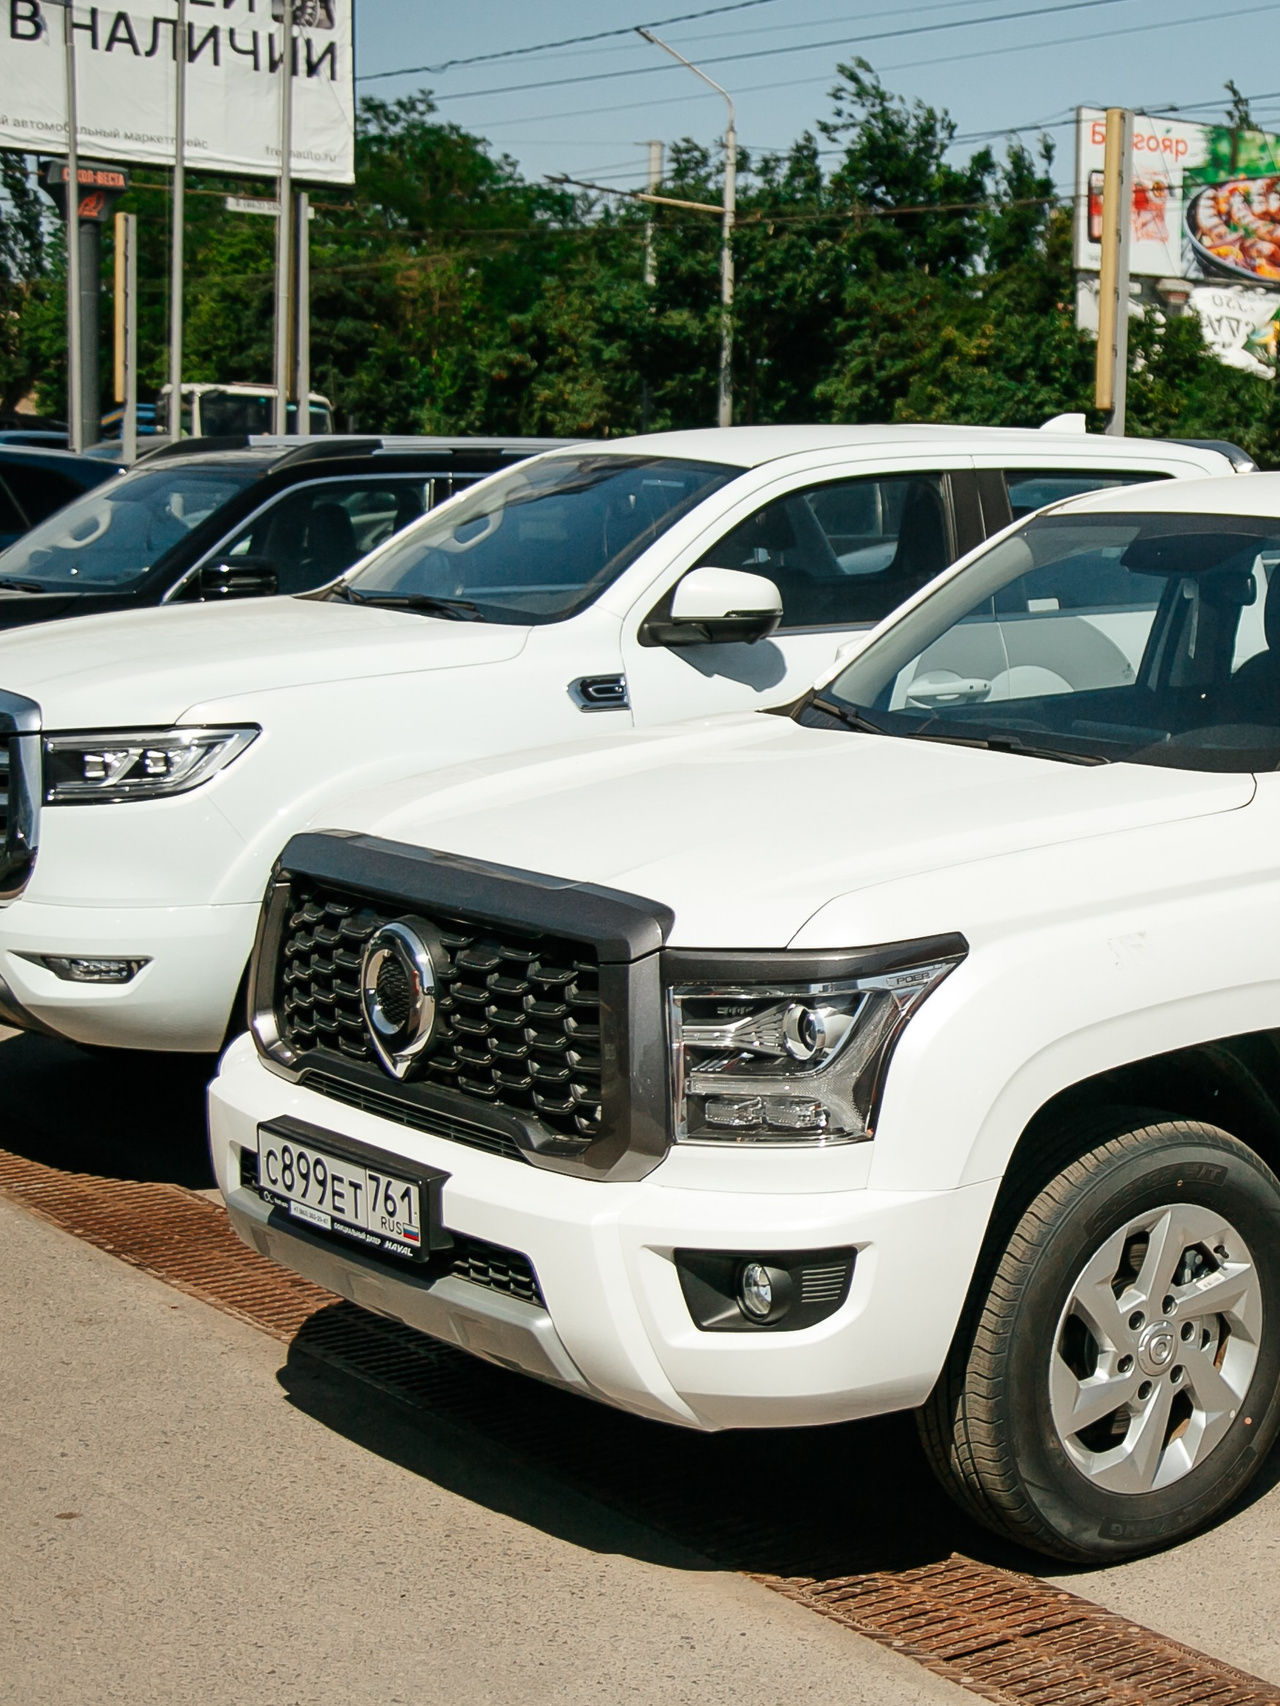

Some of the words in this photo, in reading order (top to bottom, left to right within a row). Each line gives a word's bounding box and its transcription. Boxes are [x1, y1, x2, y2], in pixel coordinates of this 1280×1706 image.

[13, 118, 121, 139] автомобльный
[125, 131, 209, 149] маркетпейс
[896, 972, 930, 985] POER
[380, 1216, 403, 1236] RUS
[384, 1240, 414, 1257] HAVAL
